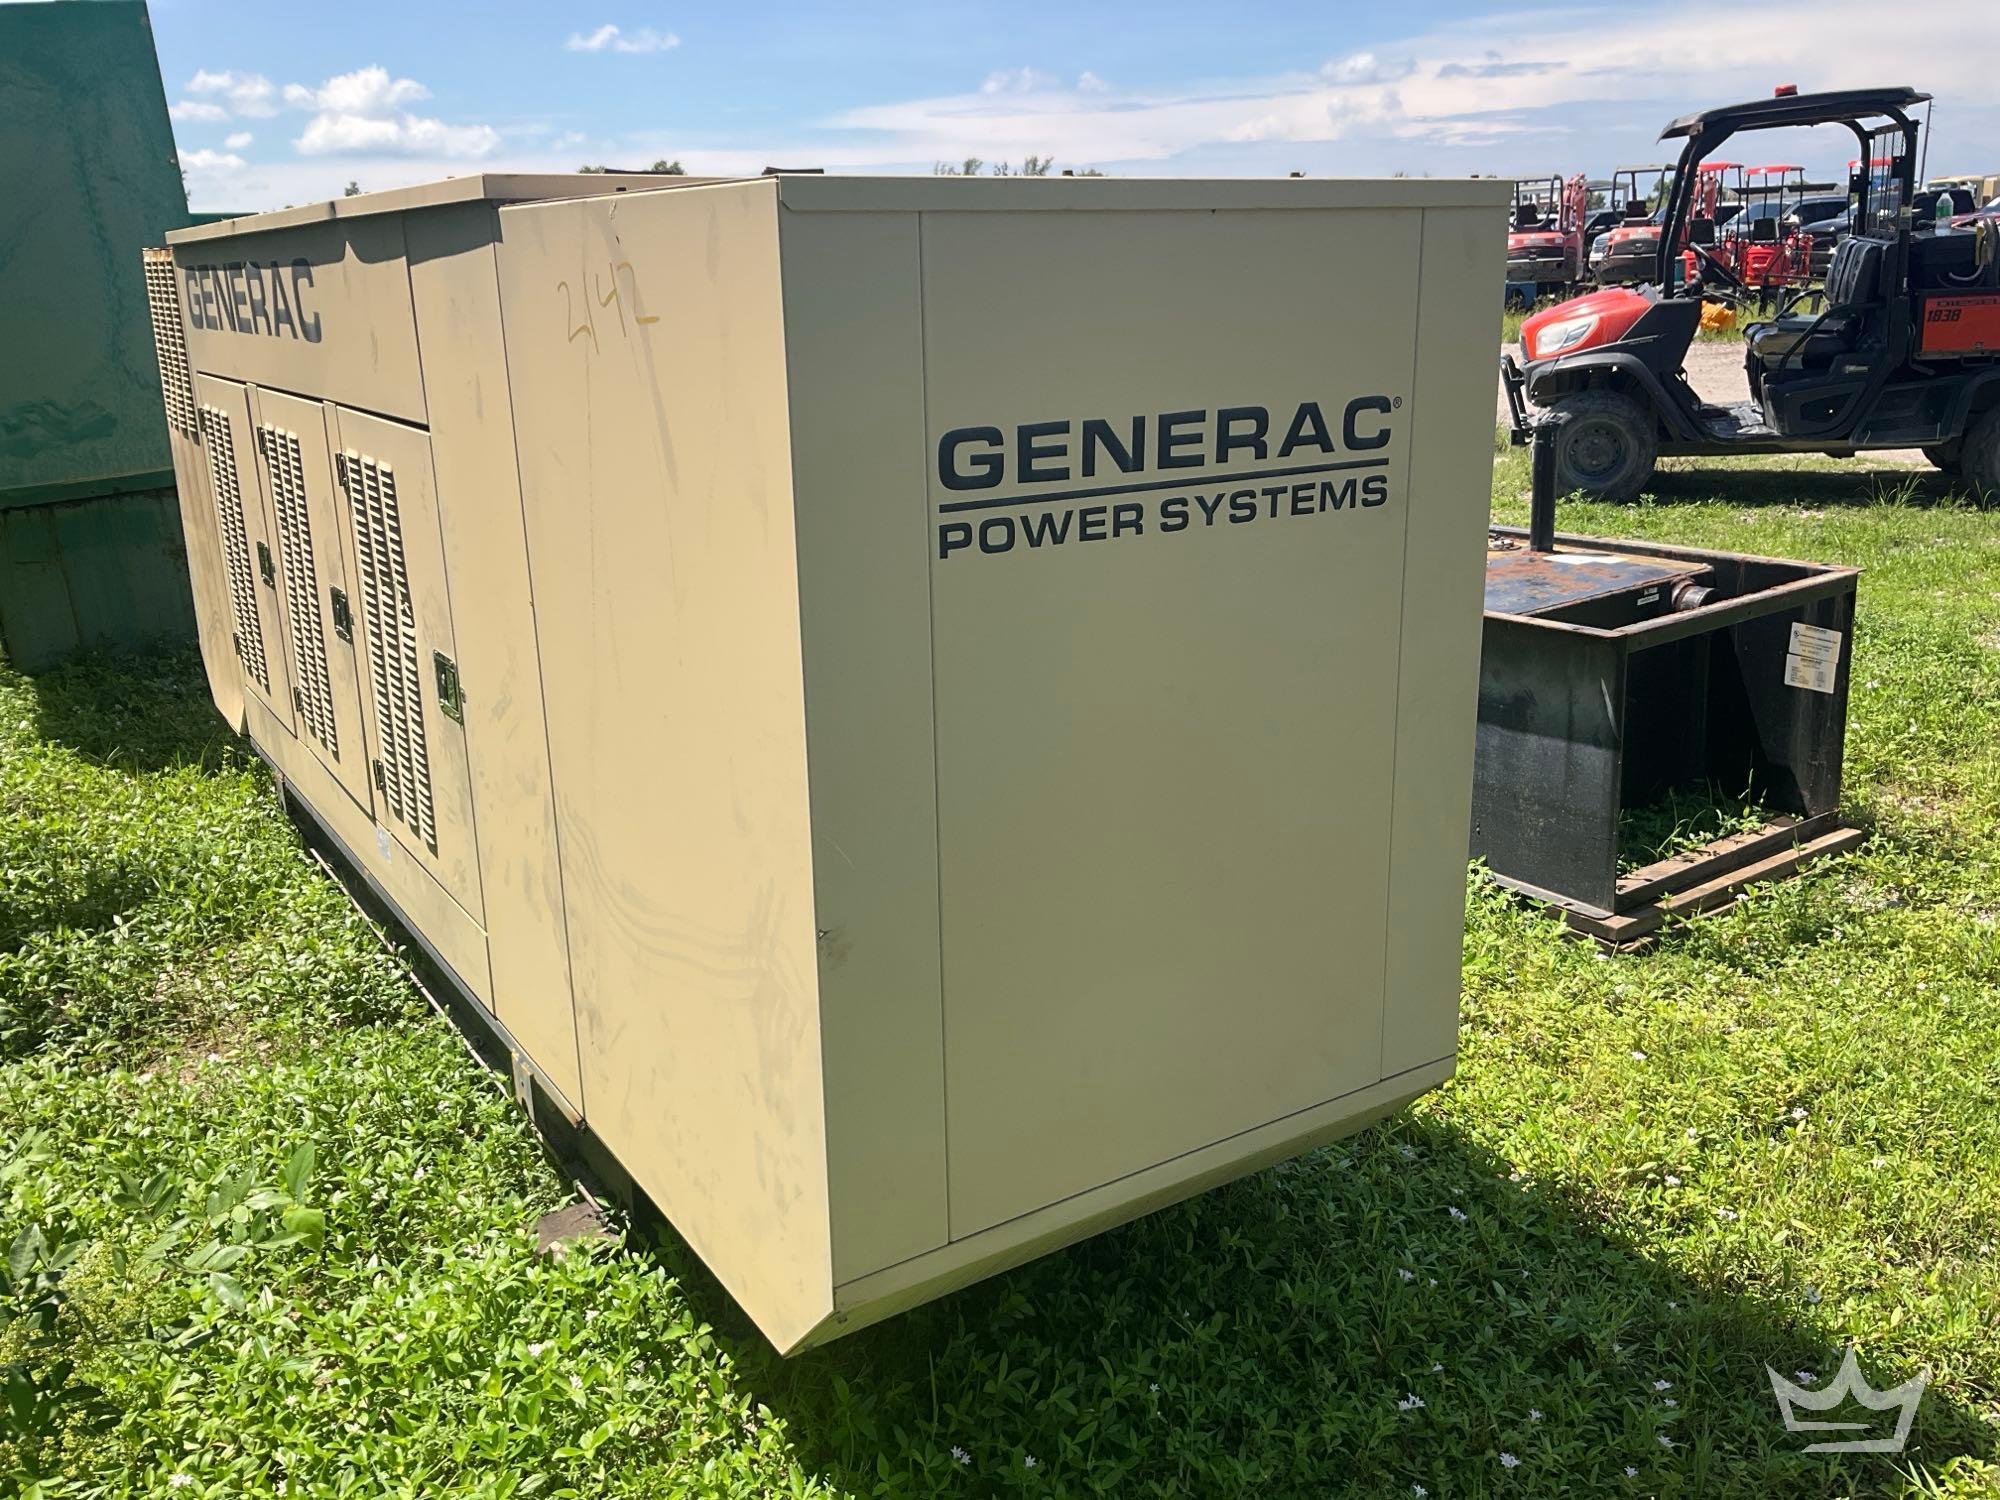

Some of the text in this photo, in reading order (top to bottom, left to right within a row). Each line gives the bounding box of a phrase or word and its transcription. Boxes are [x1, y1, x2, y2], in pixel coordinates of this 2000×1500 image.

[185, 257, 322, 344] GENERAC
[938, 474, 1389, 560] POWER SYSTEMS
